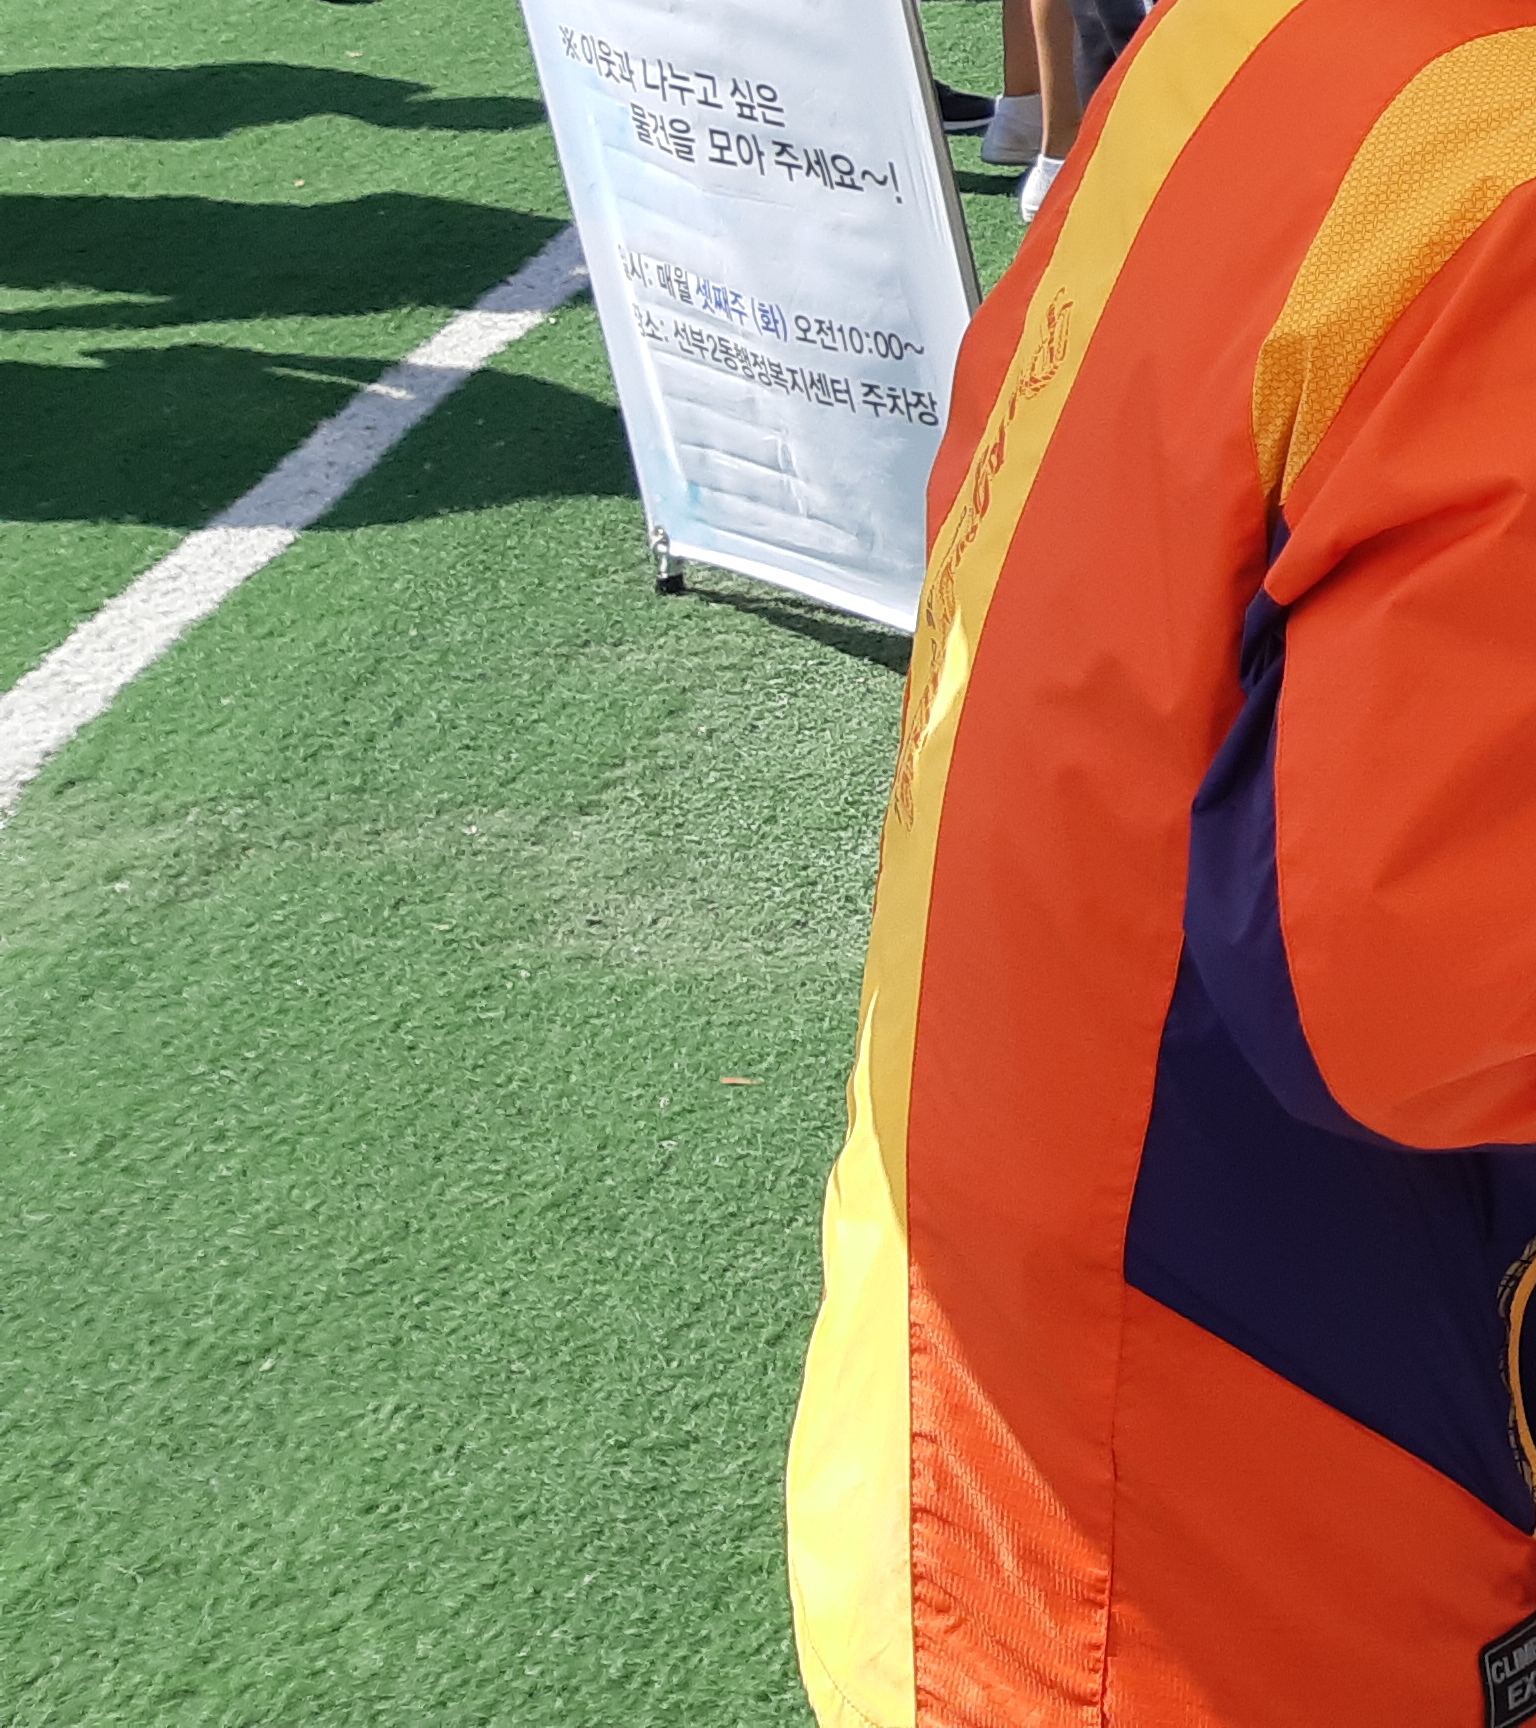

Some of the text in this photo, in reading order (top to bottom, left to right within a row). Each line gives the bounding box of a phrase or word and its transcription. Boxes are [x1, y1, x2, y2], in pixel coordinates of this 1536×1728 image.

[641, 58, 723, 109] 나누고
[730, 79, 785, 127] 싶은
[630, 103, 695, 163] 물건을
[708, 128, 766, 176] 모아
[656, 264, 693, 305] 매월
[696, 275, 748, 326] 셋째주
[751, 296, 788, 342] (화)
[674, 320, 857, 413] 선부2동행정복지센터
[859, 381, 939, 426] 주차장
